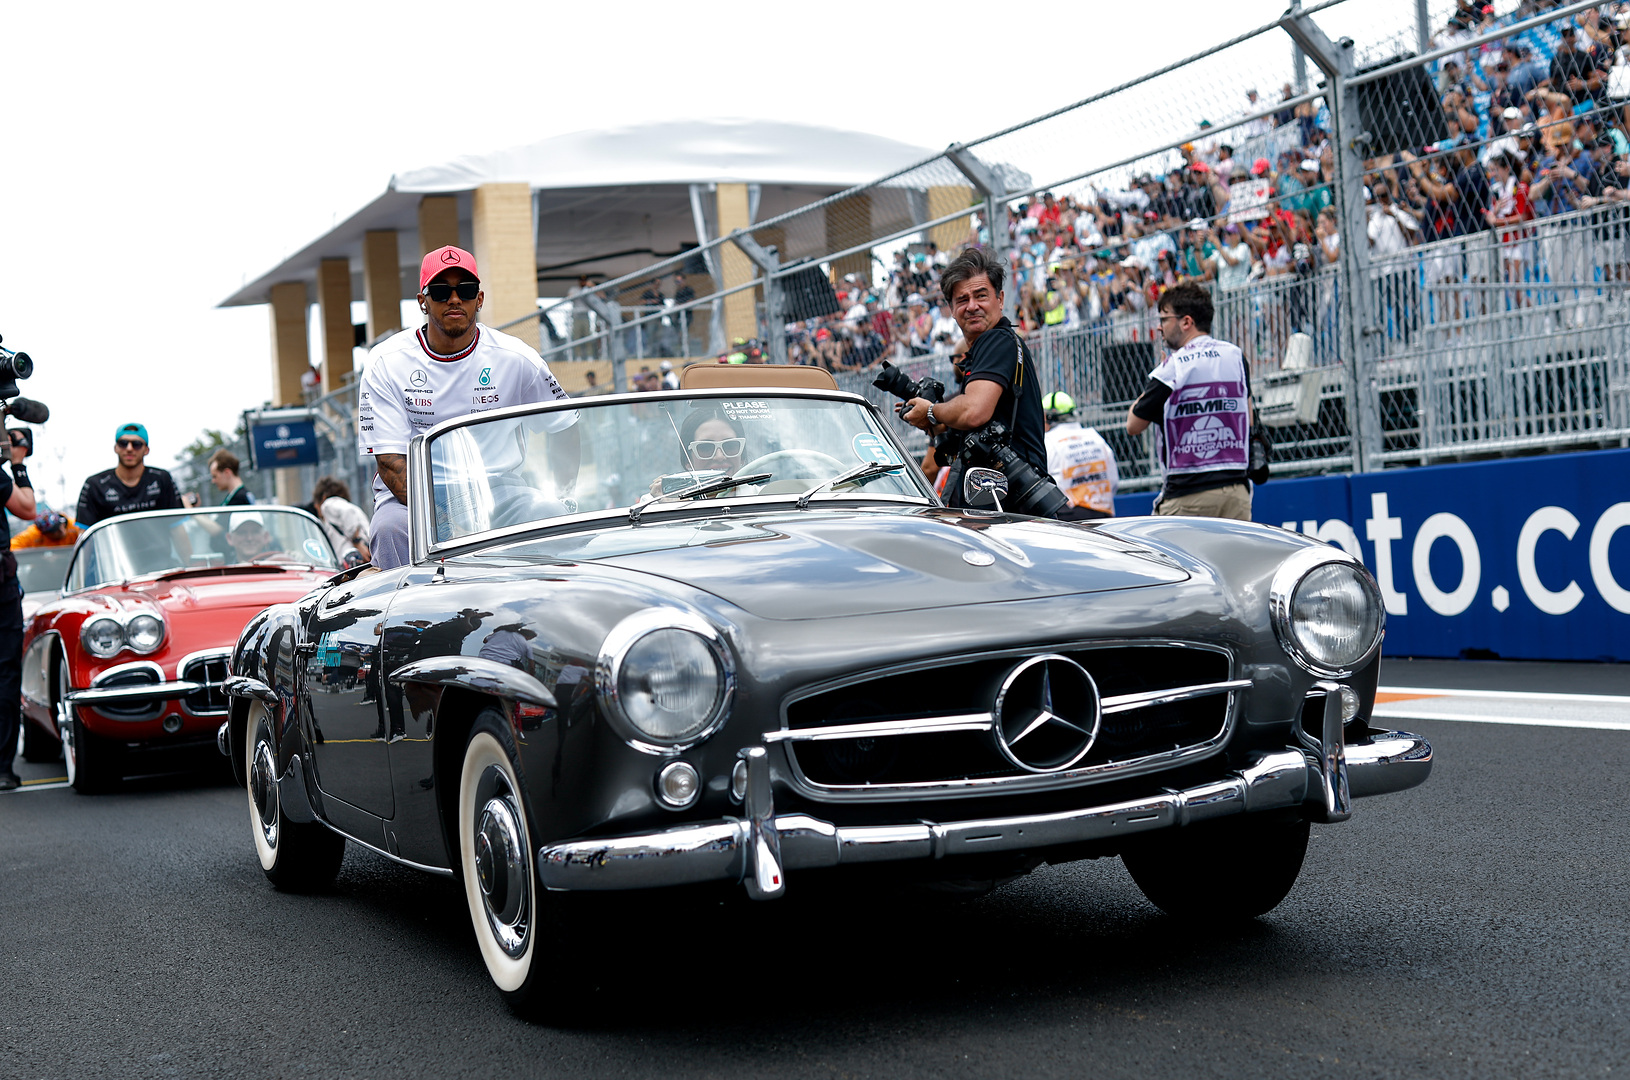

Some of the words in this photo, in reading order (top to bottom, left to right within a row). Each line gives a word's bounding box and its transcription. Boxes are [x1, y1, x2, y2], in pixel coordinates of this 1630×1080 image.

[414, 398, 433, 407] UBS
[472, 394, 499, 405] INEOS
[722, 401, 768, 409] PLEASE
[1180, 426, 1236, 445] MEDIA
[869, 447, 891, 464] 5
